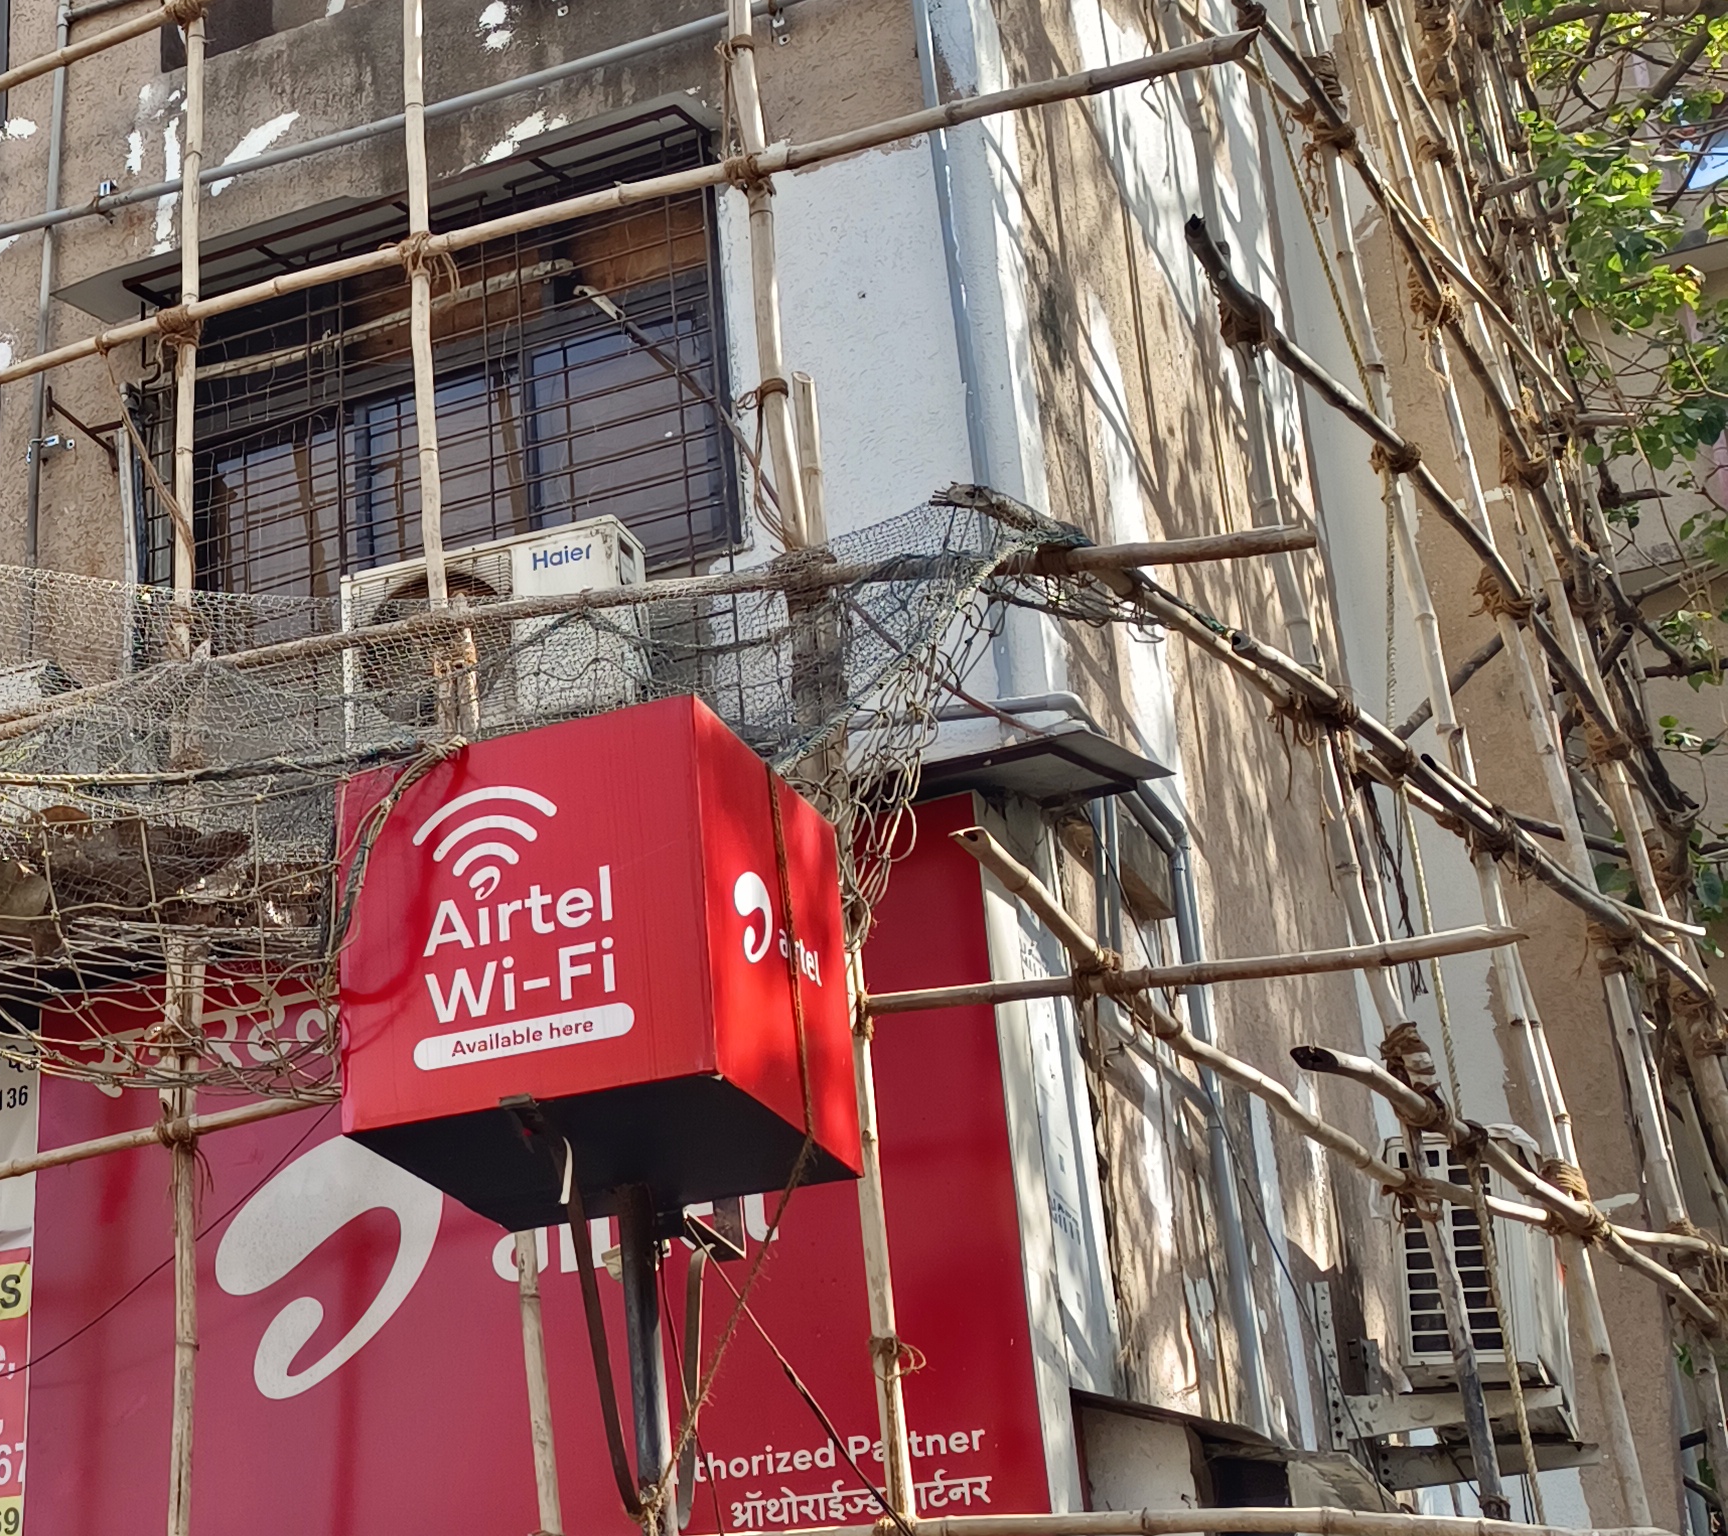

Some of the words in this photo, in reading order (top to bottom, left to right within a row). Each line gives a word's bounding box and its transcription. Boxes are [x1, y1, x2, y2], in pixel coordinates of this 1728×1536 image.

[532, 543, 592, 571] Haier
[423, 864, 613, 957] Airtel
[425, 937, 616, 1024] Wi-Fi
[779, 928, 822, 987] artel
[452, 1027, 543, 1057] Available
[550, 1020, 594, 1041] here
[673, 1438, 836, 1484] thorized
[847, 1428, 986, 1464] Patner
